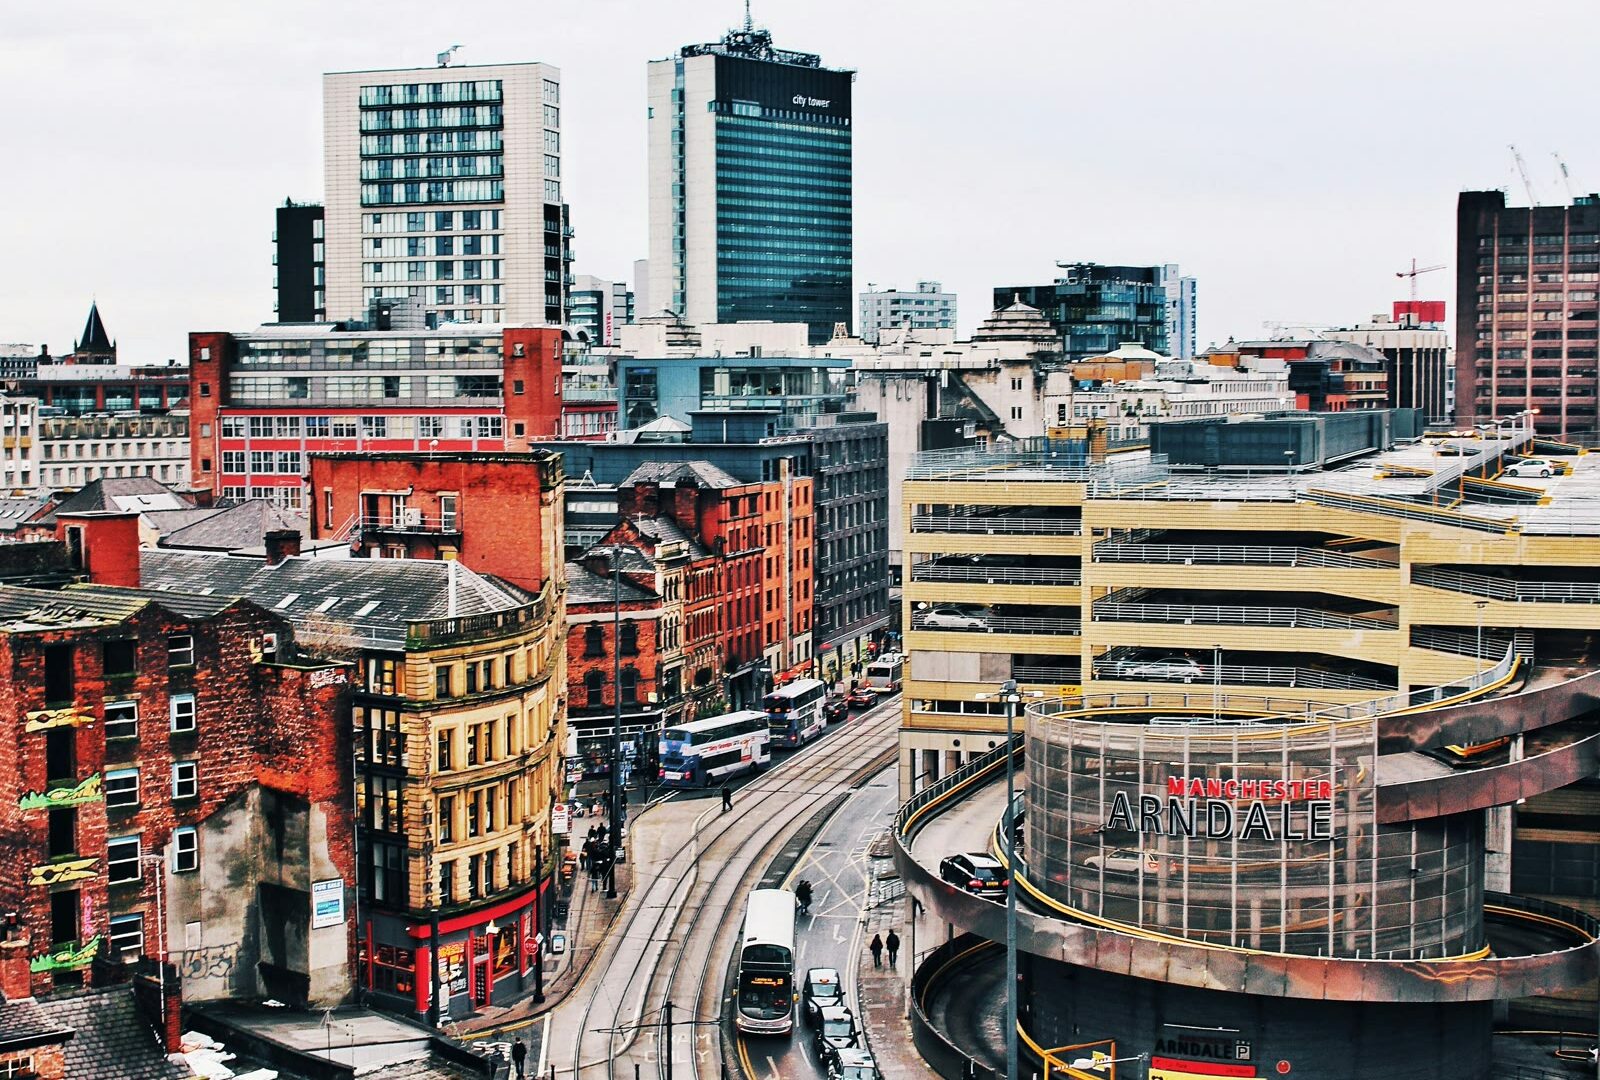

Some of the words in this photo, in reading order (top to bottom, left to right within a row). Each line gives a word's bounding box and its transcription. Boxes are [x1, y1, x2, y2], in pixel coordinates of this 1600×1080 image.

[793, 94, 806, 107] city
[808, 96, 830, 107] tower
[1168, 776, 1331, 799] MANCHESTER
[1107, 790, 1332, 841] ARNDALE
[1154, 1038, 1232, 1059] ARNDALE
